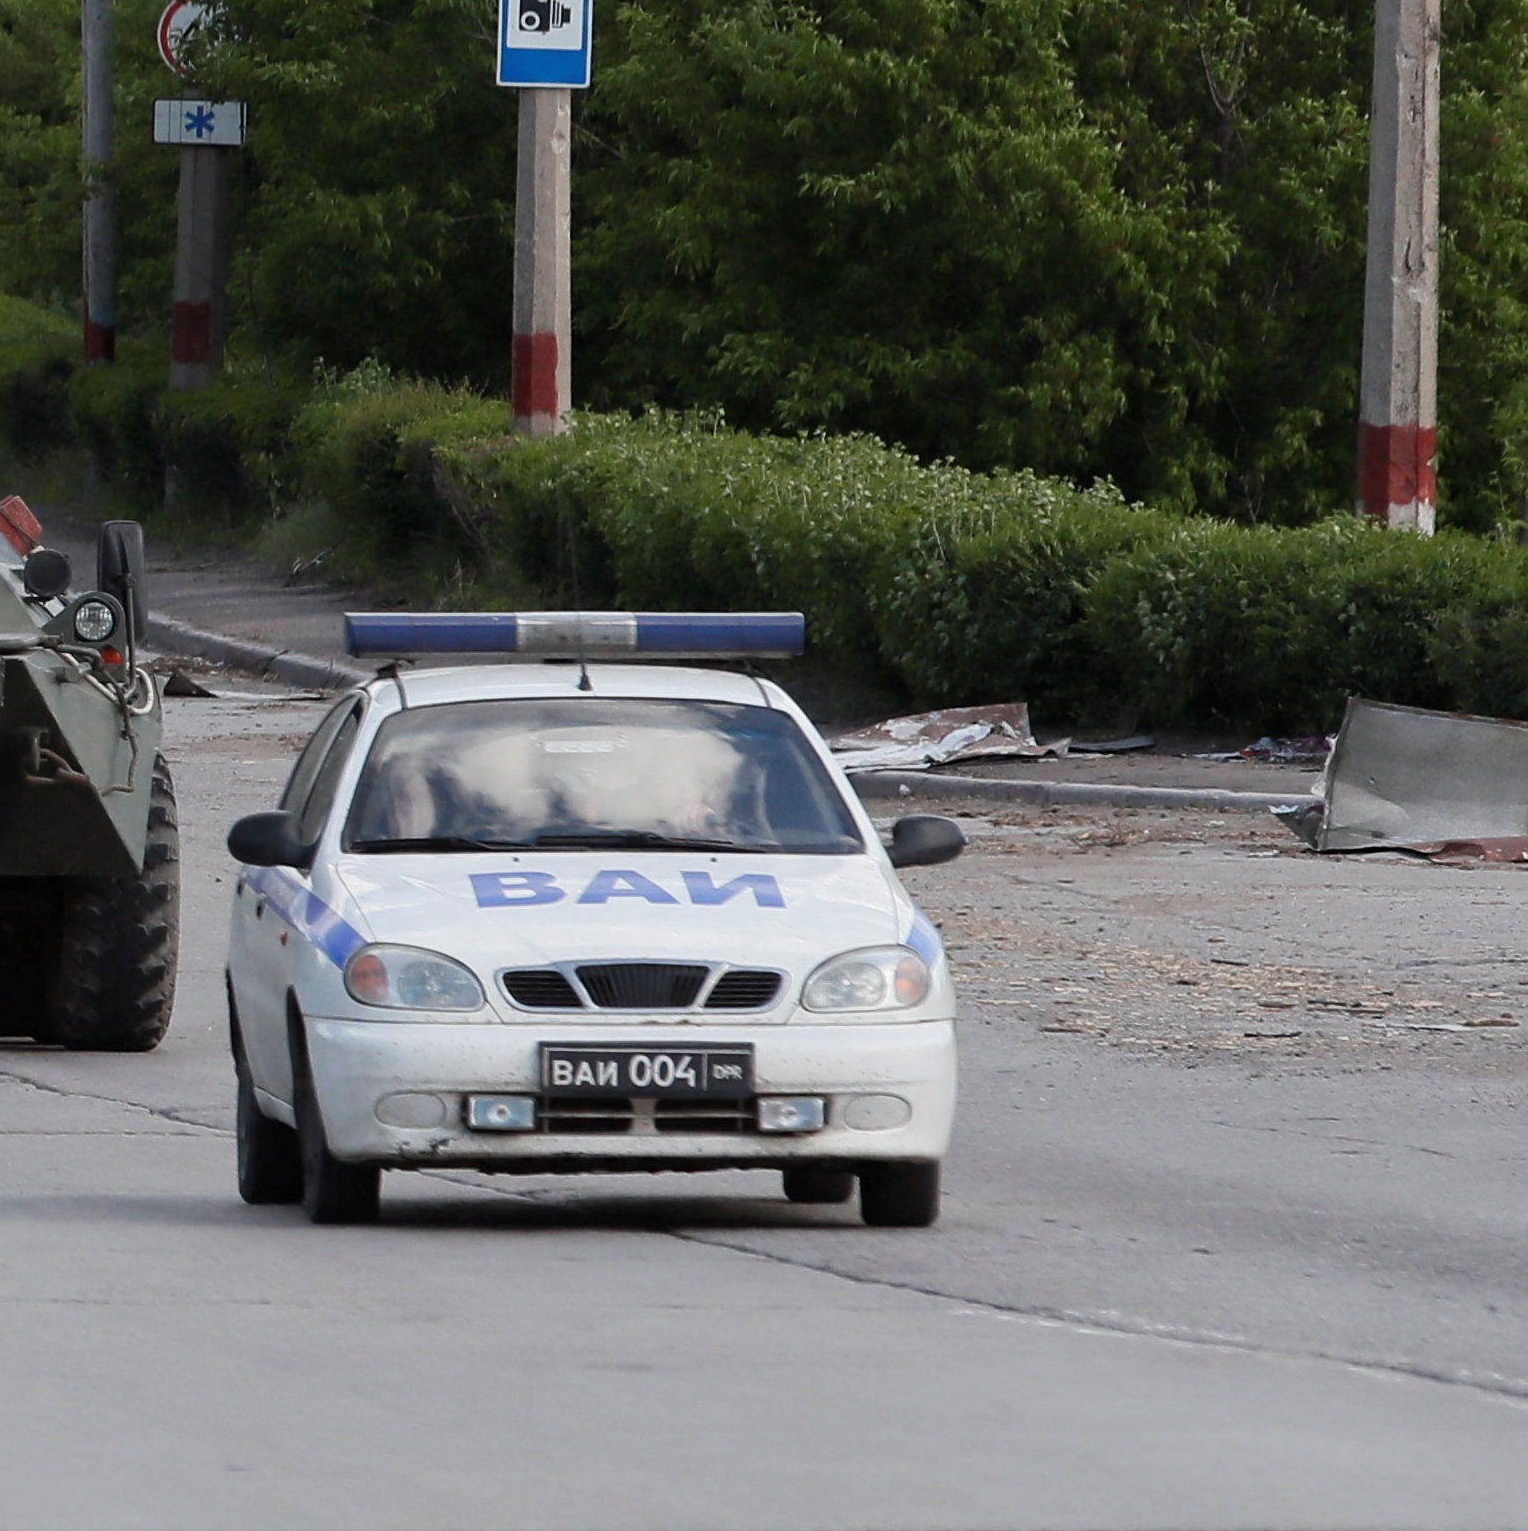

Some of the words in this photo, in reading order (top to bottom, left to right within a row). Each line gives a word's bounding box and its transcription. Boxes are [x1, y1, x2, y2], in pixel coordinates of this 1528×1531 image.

[468, 870, 787, 908] ВАИ
[551, 1060, 619, 1086] ВАИ
[628, 1054, 696, 1087] 004
